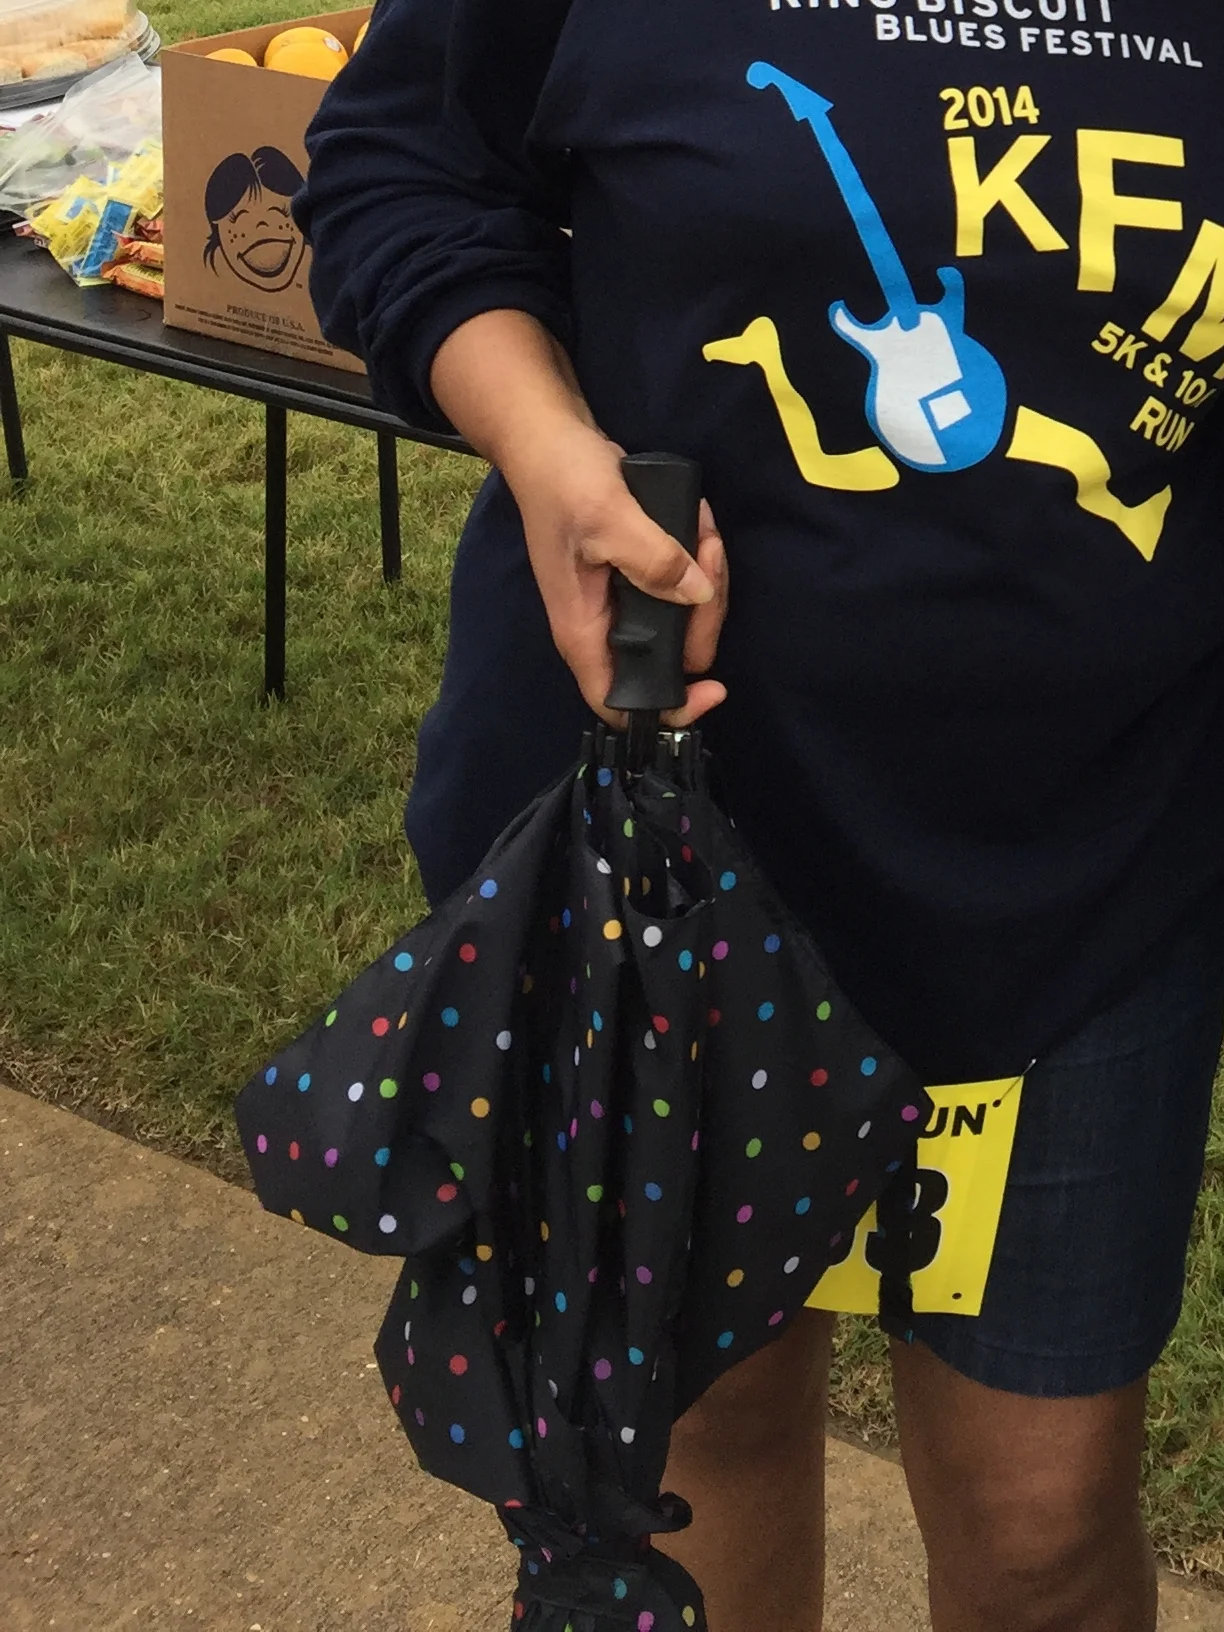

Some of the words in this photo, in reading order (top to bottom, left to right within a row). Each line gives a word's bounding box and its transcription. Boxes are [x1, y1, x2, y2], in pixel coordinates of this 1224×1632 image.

[876, 13, 1006, 50] BLUES
[1020, 27, 1203, 68] FESTIVAL
[939, 85, 1040, 130] 2014
[226, 304, 267, 322] PRODUCT
[1091, 322, 1148, 369] 5K
[1143, 353, 1172, 388] &
[1130, 395, 1195, 452] RUN
